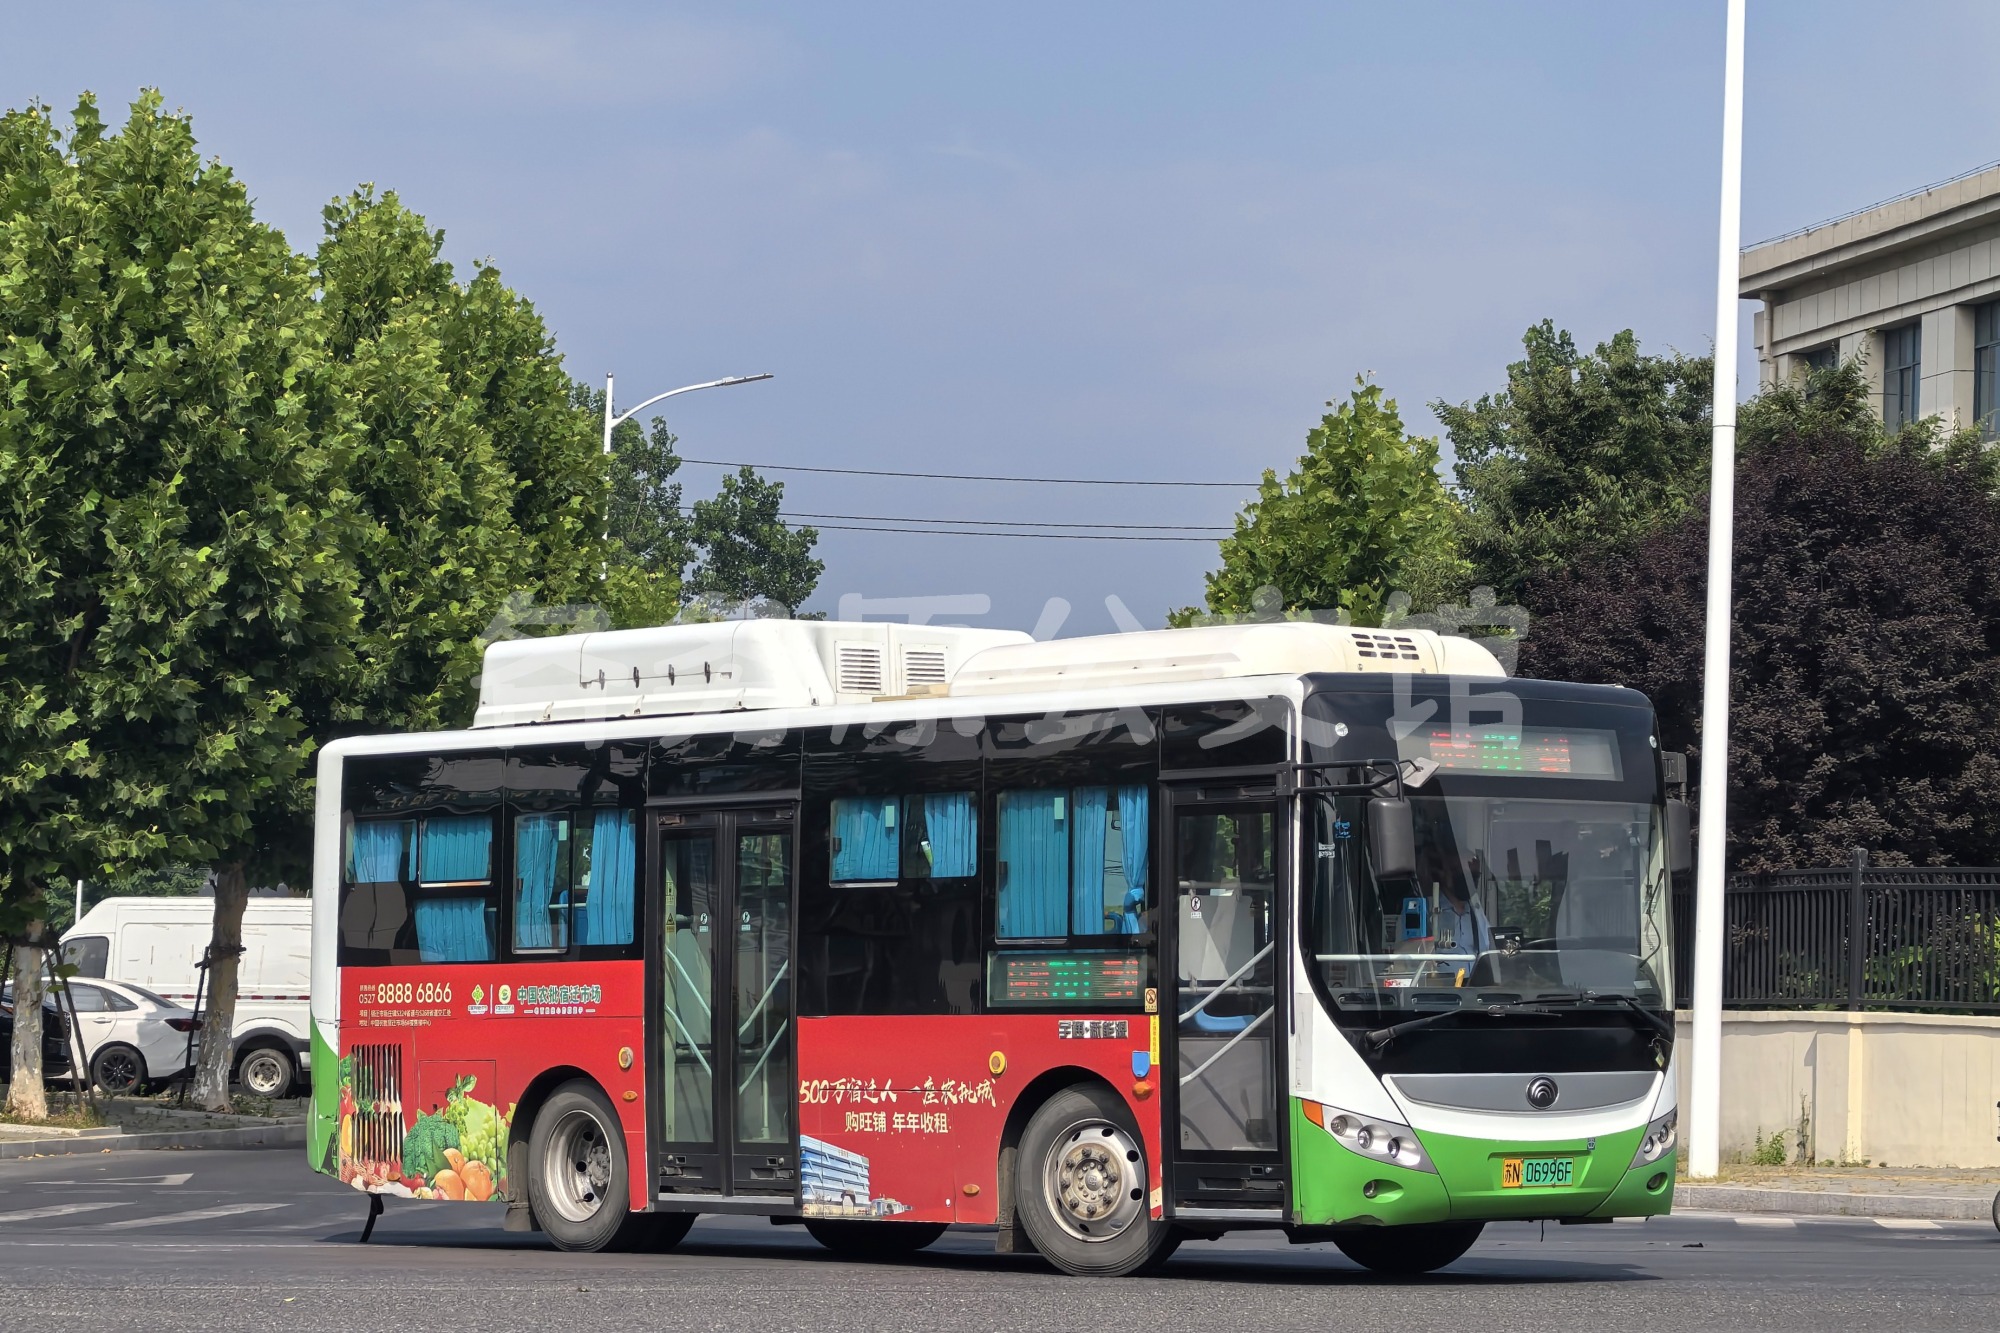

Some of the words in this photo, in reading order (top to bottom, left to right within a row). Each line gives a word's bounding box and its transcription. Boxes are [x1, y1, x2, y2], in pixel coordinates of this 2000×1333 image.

[359, 994, 376, 1004] 0527
[377, 983, 413, 1004] 8888
[416, 982, 452, 1003] 6866
[517, 984, 602, 1004] 中国农批宿迁市场
[799, 1078, 898, 1105] 500万宿迁人
[845, 1112, 887, 1132] 购旺铺
[892, 1112, 949, 1133] 年年收租
